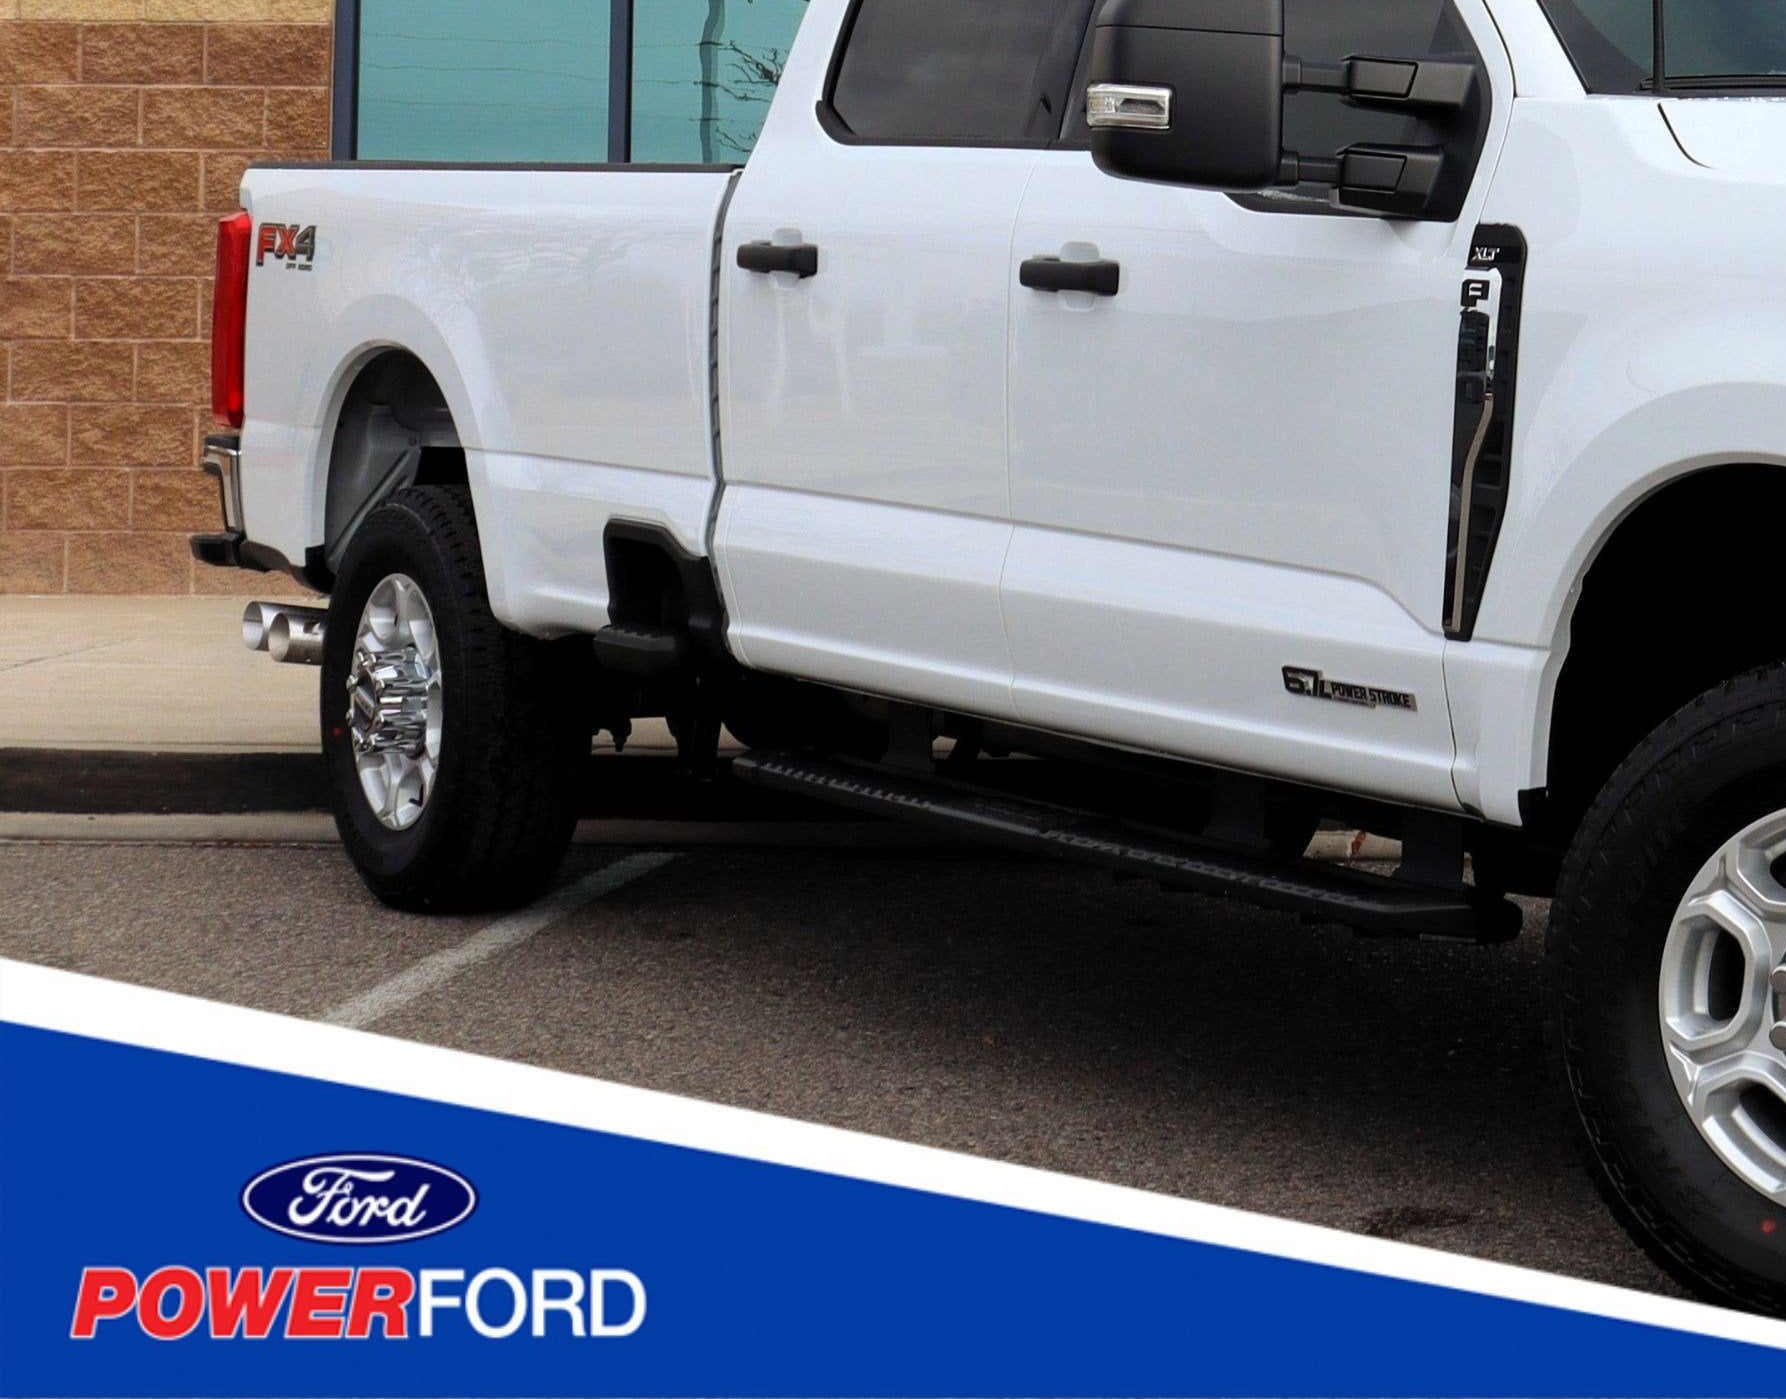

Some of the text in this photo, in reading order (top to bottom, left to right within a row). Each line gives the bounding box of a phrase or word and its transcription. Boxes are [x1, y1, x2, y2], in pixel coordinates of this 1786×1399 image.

[256, 223, 316, 266] FX4
[1471, 246, 1500, 261] XLT
[1332, 682, 1367, 699] POWER
[1369, 689, 1412, 709] STROKE
